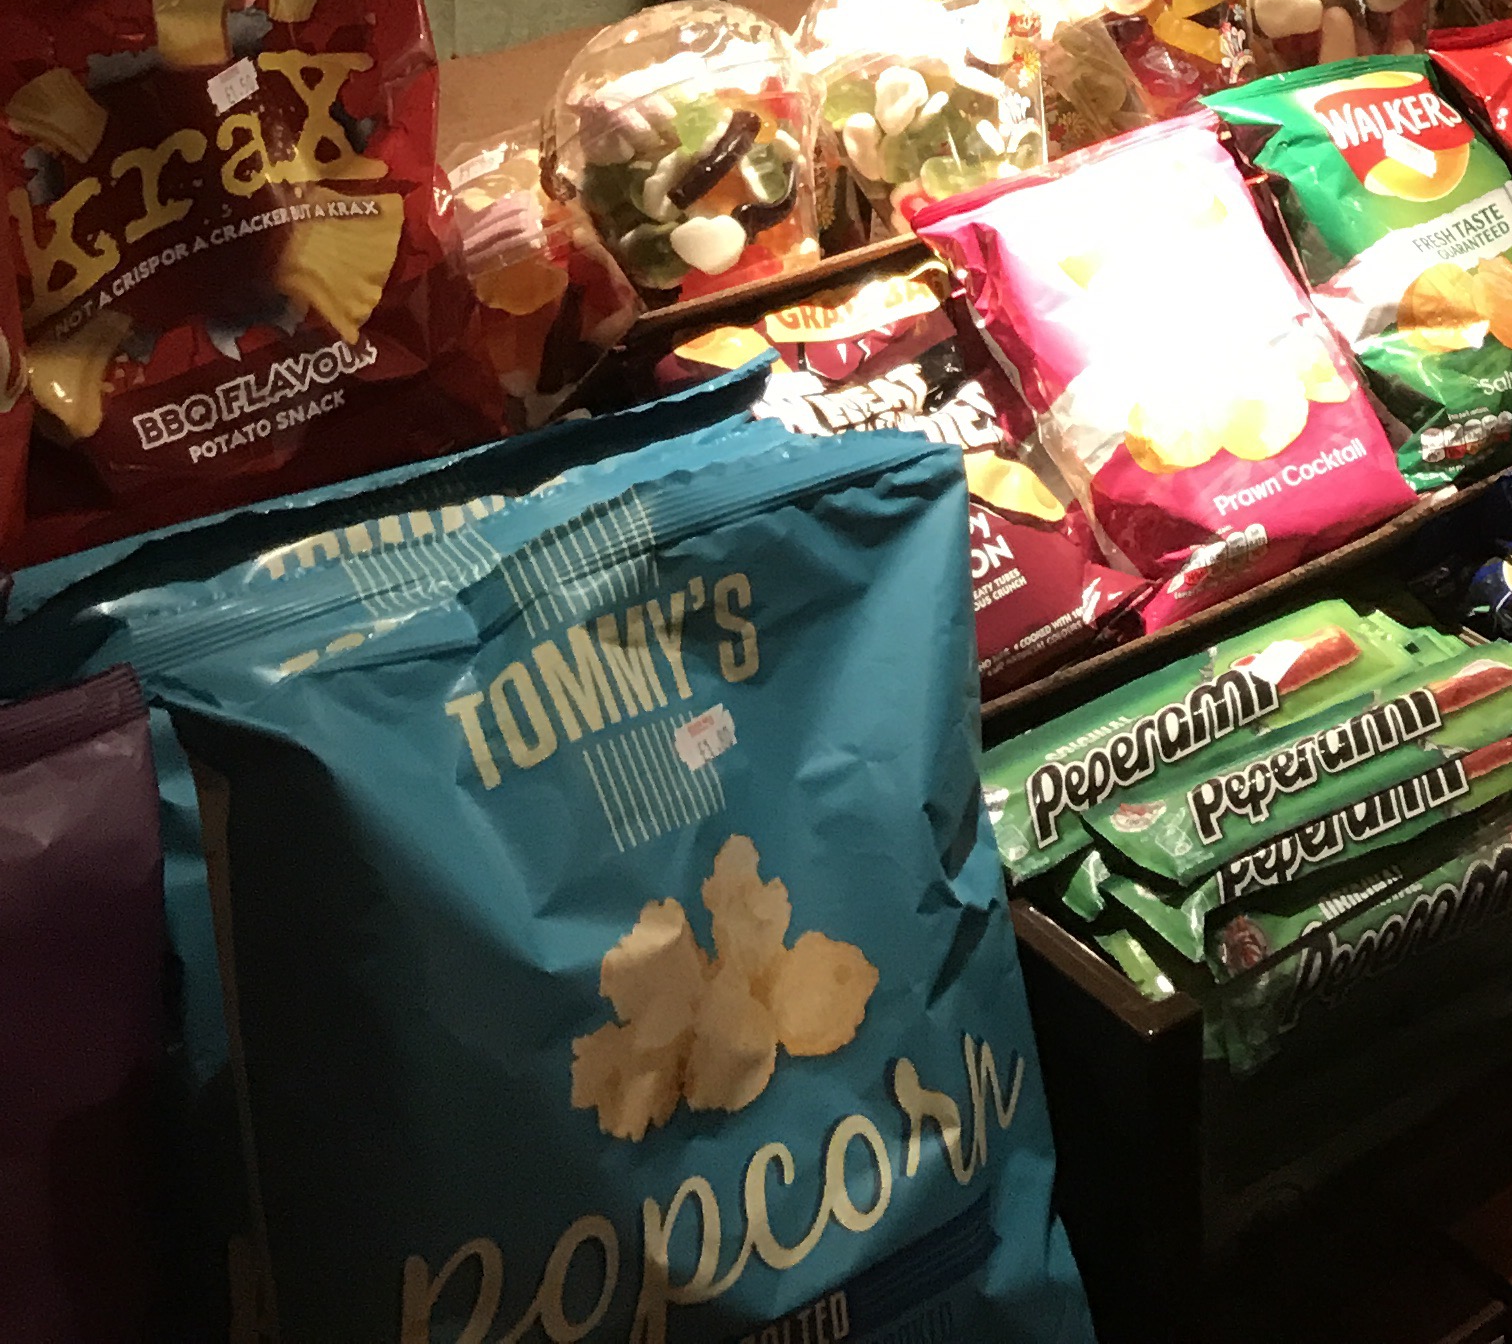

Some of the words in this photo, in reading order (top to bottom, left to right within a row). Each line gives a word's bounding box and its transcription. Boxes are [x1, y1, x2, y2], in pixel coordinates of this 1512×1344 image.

[1316, 88, 1462, 152] WALKERS
[209, 204, 288, 246] CRACKER
[328, 199, 380, 218] KRAX
[1411, 227, 1456, 255] FRESH
[1453, 202, 1505, 235] TASTE
[1436, 220, 1511, 262] GUARANTEED
[132, 393, 218, 451] BBQ
[188, 418, 273, 464] POTATO
[274, 388, 347, 432] SNACK
[1213, 476, 1283, 517] Prawn
[1281, 437, 1368, 488] Cocktail
[445, 572, 763, 792] TOMMY'S
[400, 1030, 1028, 1344] popcorn
